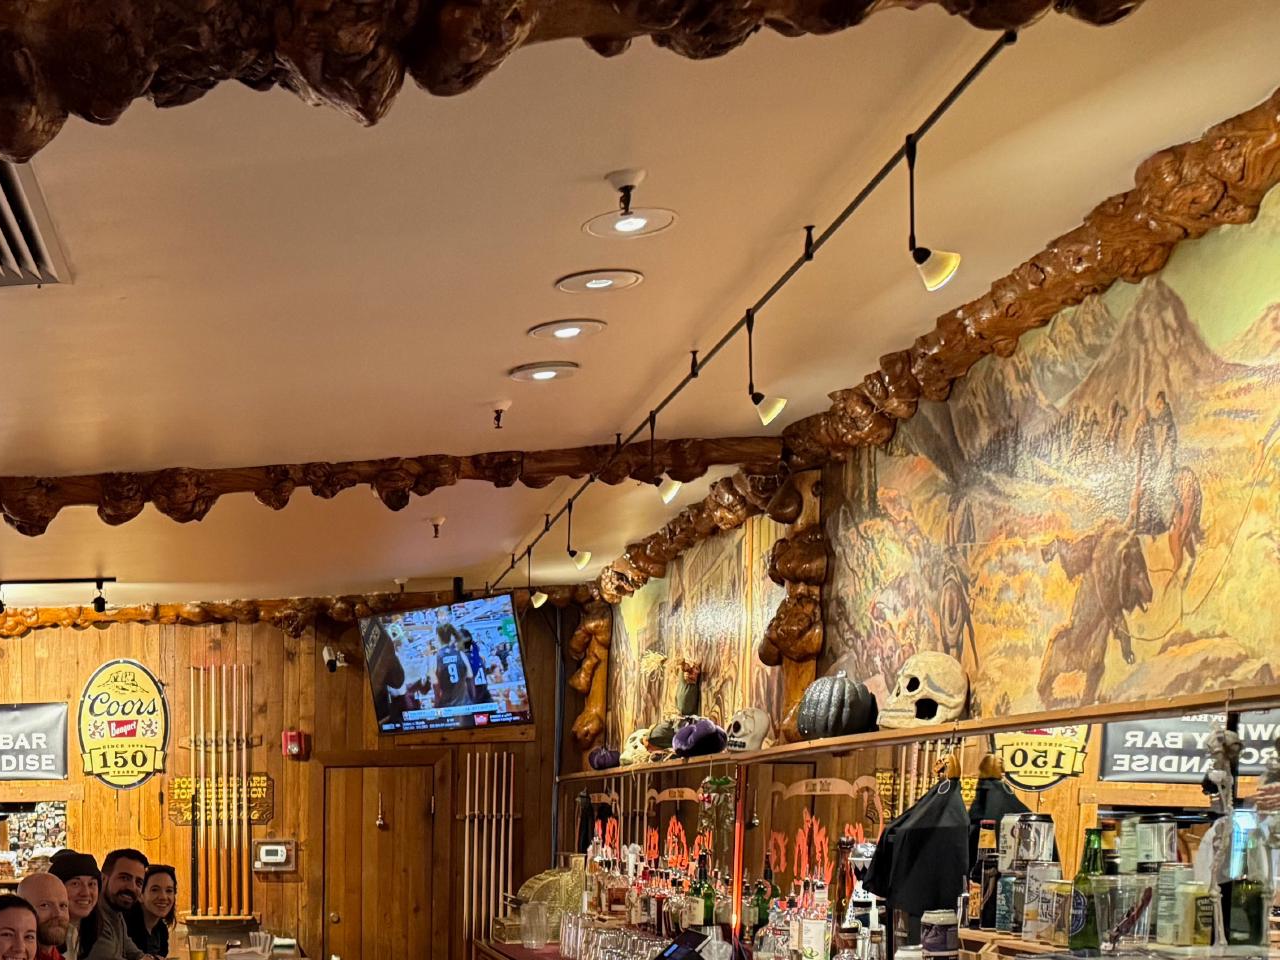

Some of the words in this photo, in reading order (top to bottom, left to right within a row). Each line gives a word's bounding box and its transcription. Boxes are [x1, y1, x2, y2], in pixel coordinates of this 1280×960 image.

[88, 692, 158, 717] Coors
[110, 721, 137, 737] Banquet
[99, 750, 148, 769] 150
